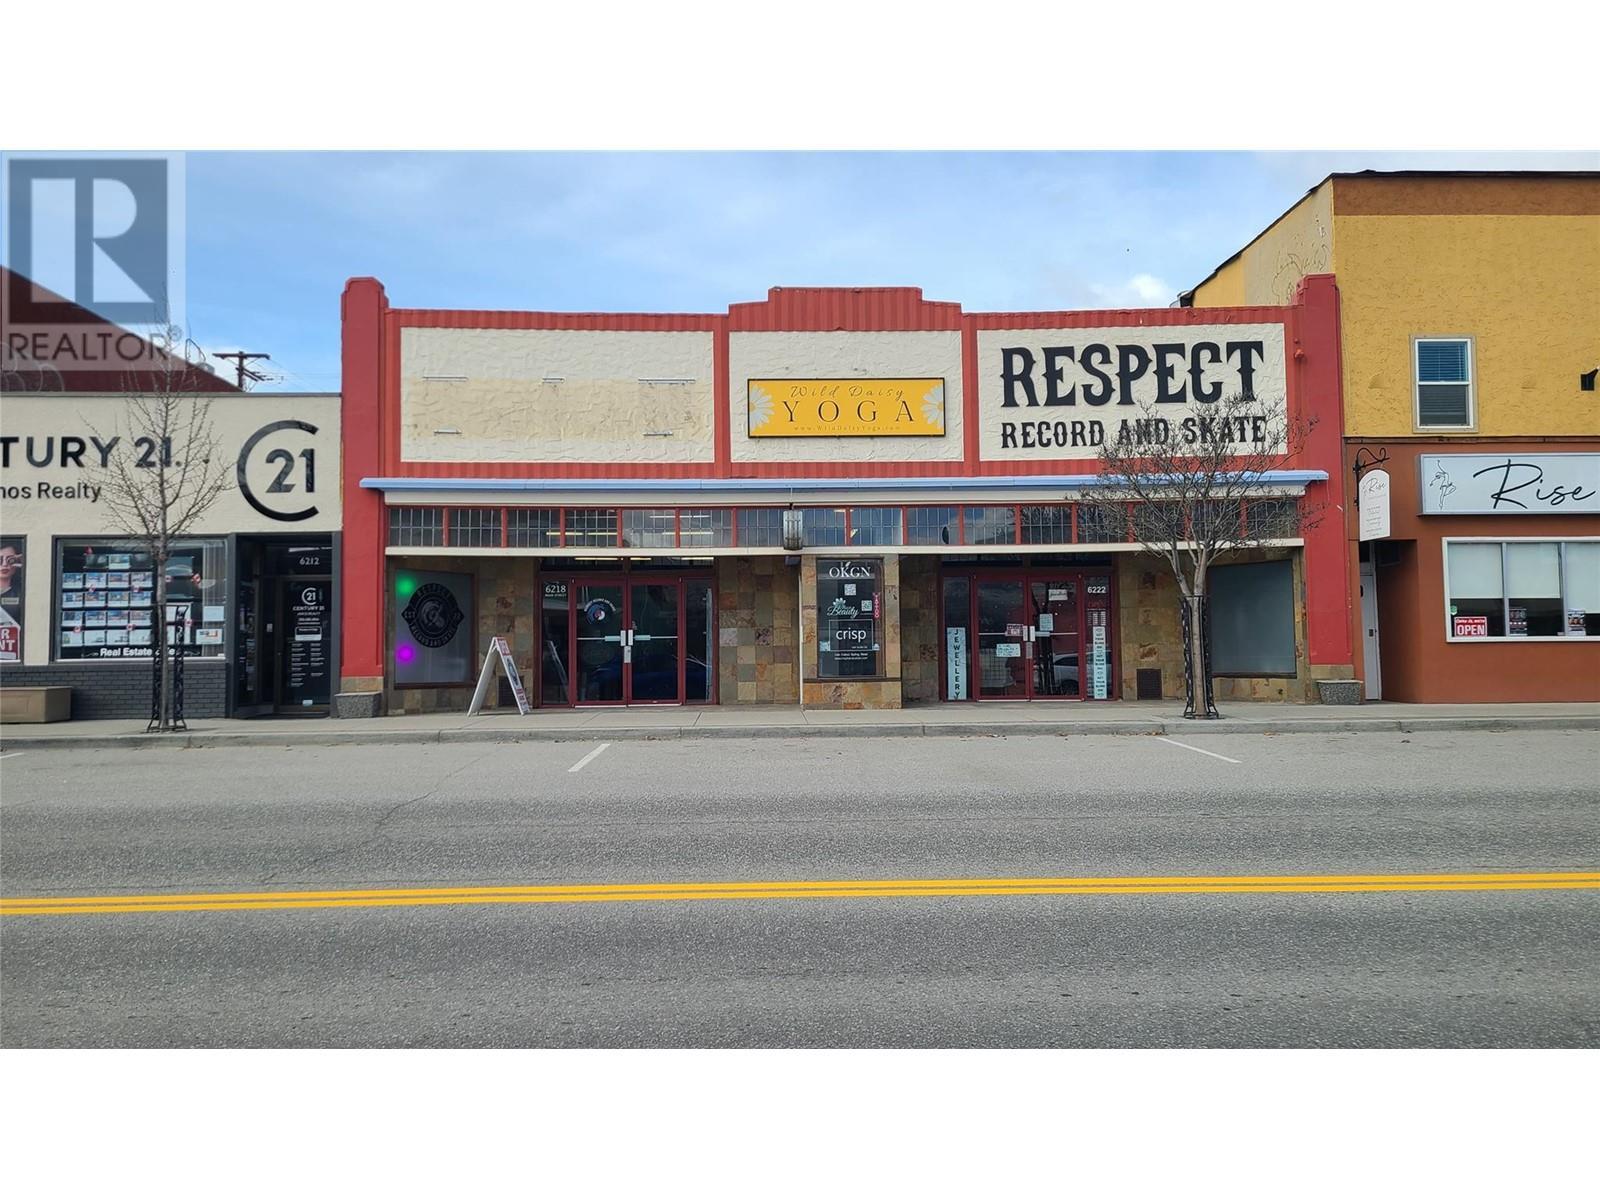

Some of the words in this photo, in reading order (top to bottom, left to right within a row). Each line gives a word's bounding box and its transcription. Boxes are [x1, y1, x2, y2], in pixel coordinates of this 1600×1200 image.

[1000, 340, 1264, 408] RESPECT
[790, 385, 840, 398] Wild
[849, 385, 904, 401] Daisy
[782, 400, 914, 423] YOGA
[1001, 420, 1104, 449] RECORD
[1117, 419, 1169, 446] AND
[1183, 415, 1267, 445] SKATE
[1472, 459, 1597, 509] Rise
[38, 482, 102, 503] Realty
[299, 557, 320, 566] 6212
[829, 561, 871, 578] OKGN
[545, 585, 567, 594] 6218
[1087, 586, 1106, 594] 6222
[835, 627, 867, 643] crisp
[1456, 625, 1486, 636] OPEN
[100, 647, 121, 657] Real
[122, 647, 153, 656] Estate
[953, 628, 961, 699] JEWELLERY
